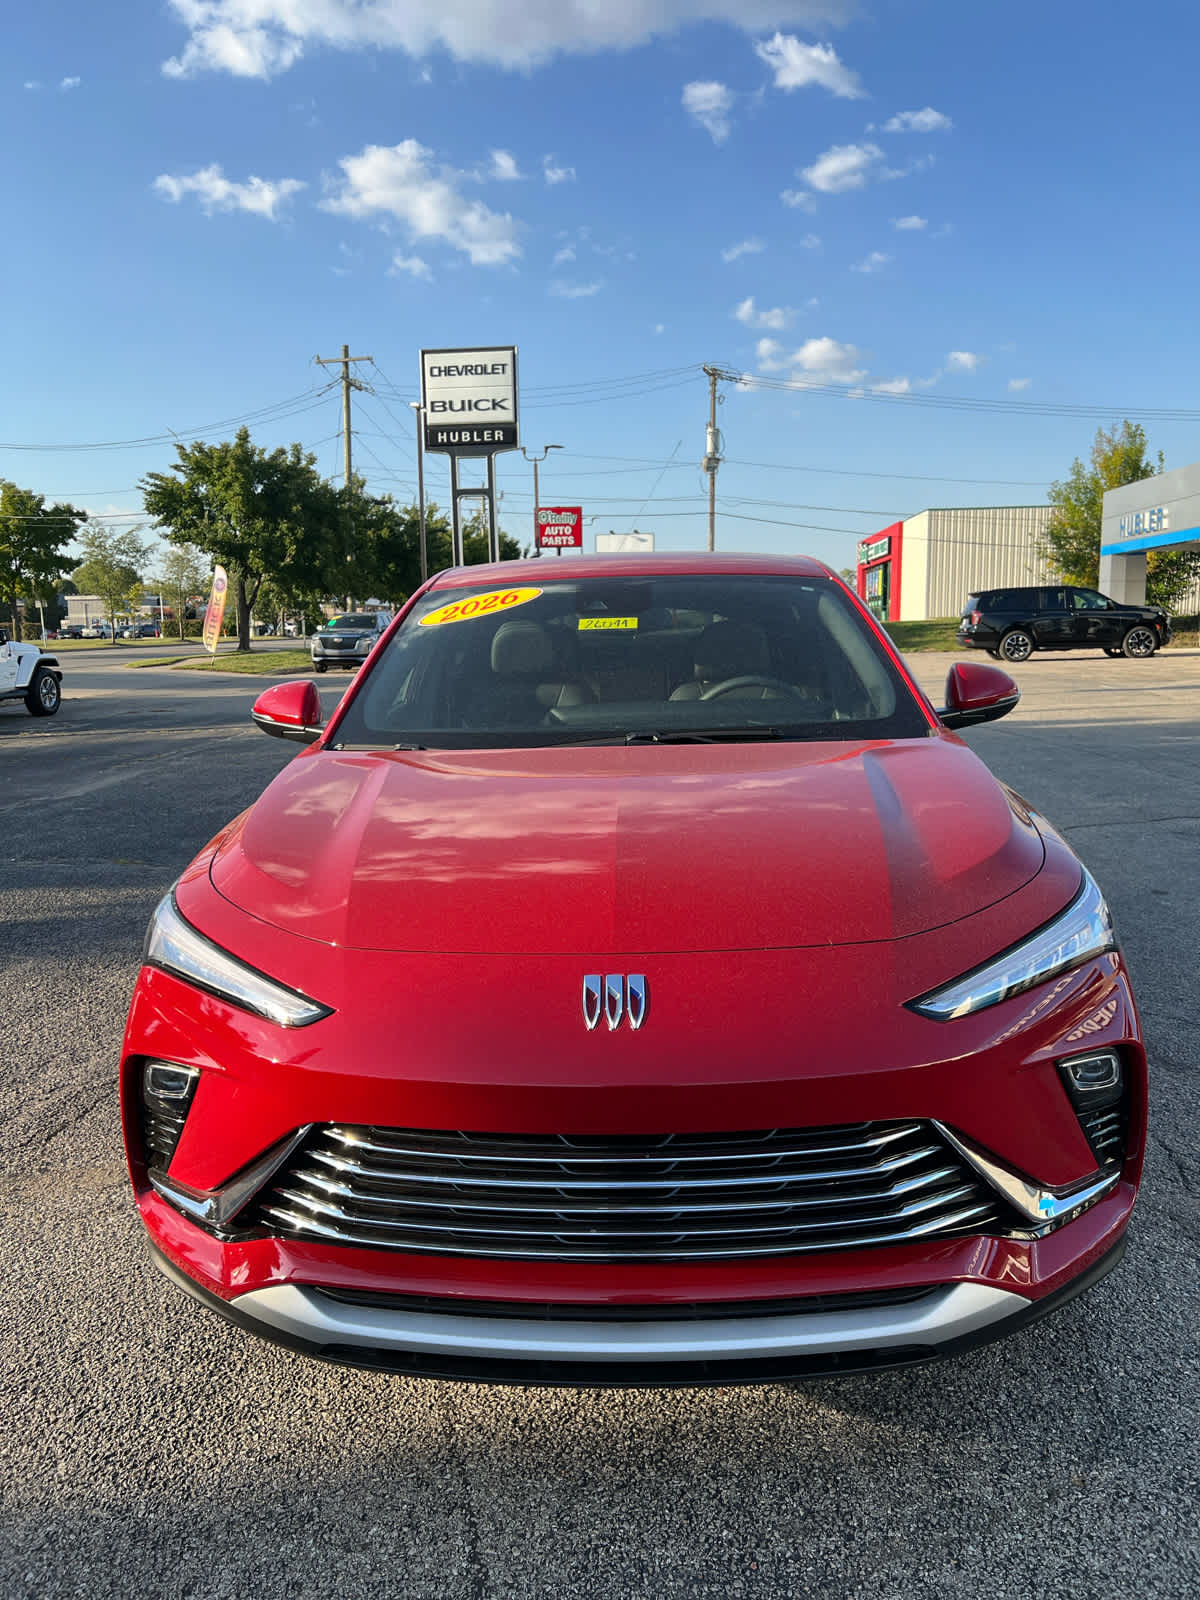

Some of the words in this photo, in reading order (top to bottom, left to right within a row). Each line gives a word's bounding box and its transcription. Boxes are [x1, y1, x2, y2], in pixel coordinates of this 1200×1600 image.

[430, 363, 508, 377] CHEVROLET
[430, 398, 510, 413] BUICK
[438, 430, 504, 443] HUBLER
[1120, 507, 1168, 537] HUBLER
[544, 526, 572, 536] AUTO
[542, 535, 575, 545] PARTS
[440, 591, 519, 622] 2026
